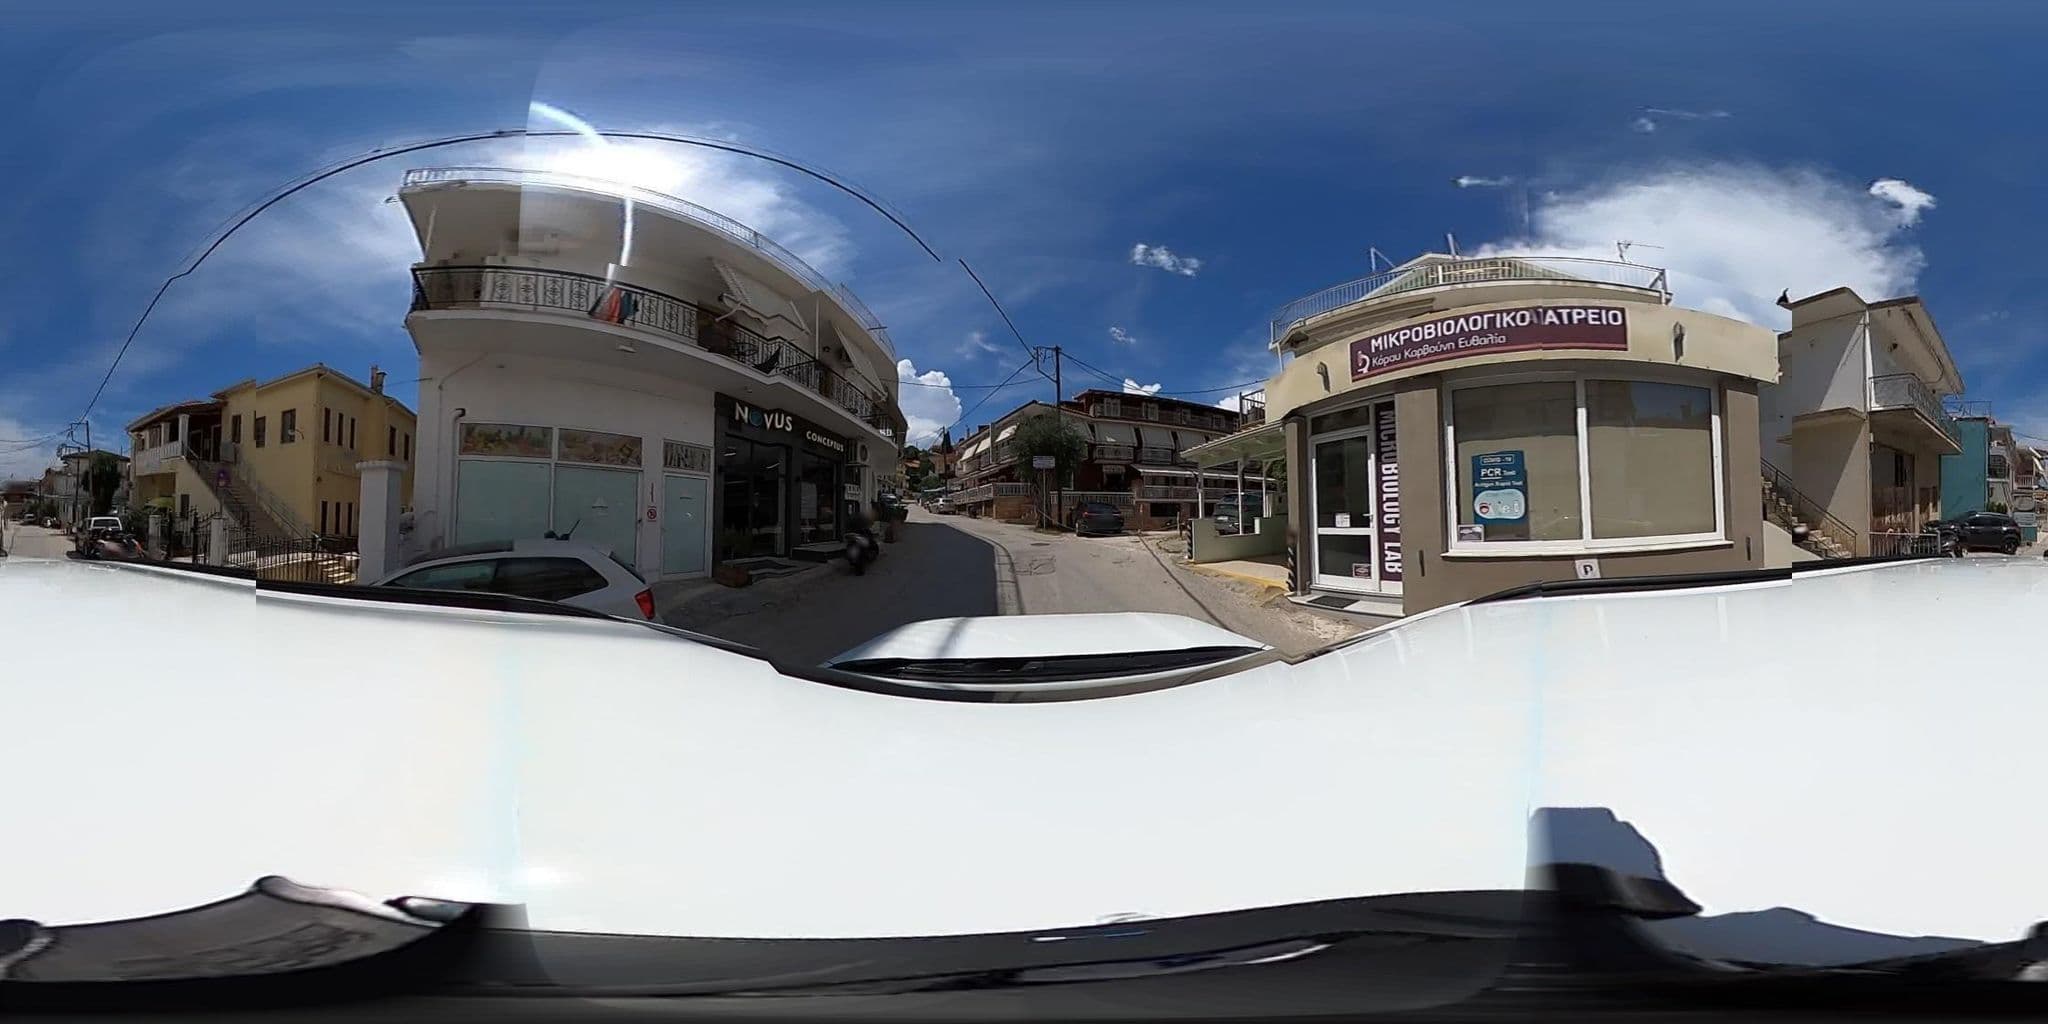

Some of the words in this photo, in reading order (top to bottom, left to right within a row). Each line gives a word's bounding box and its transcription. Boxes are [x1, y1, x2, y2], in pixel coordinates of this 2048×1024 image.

[1370, 310, 1530, 353] ΜΙΚΡΟΒΙΟΛΟΓΙΚΟ
[735, 401, 793, 432] NOVUS
[1380, 410, 1401, 535] MICROBIOLOGY
[1480, 468, 1501, 476] PCR
[1384, 542, 1402, 573] LAB
